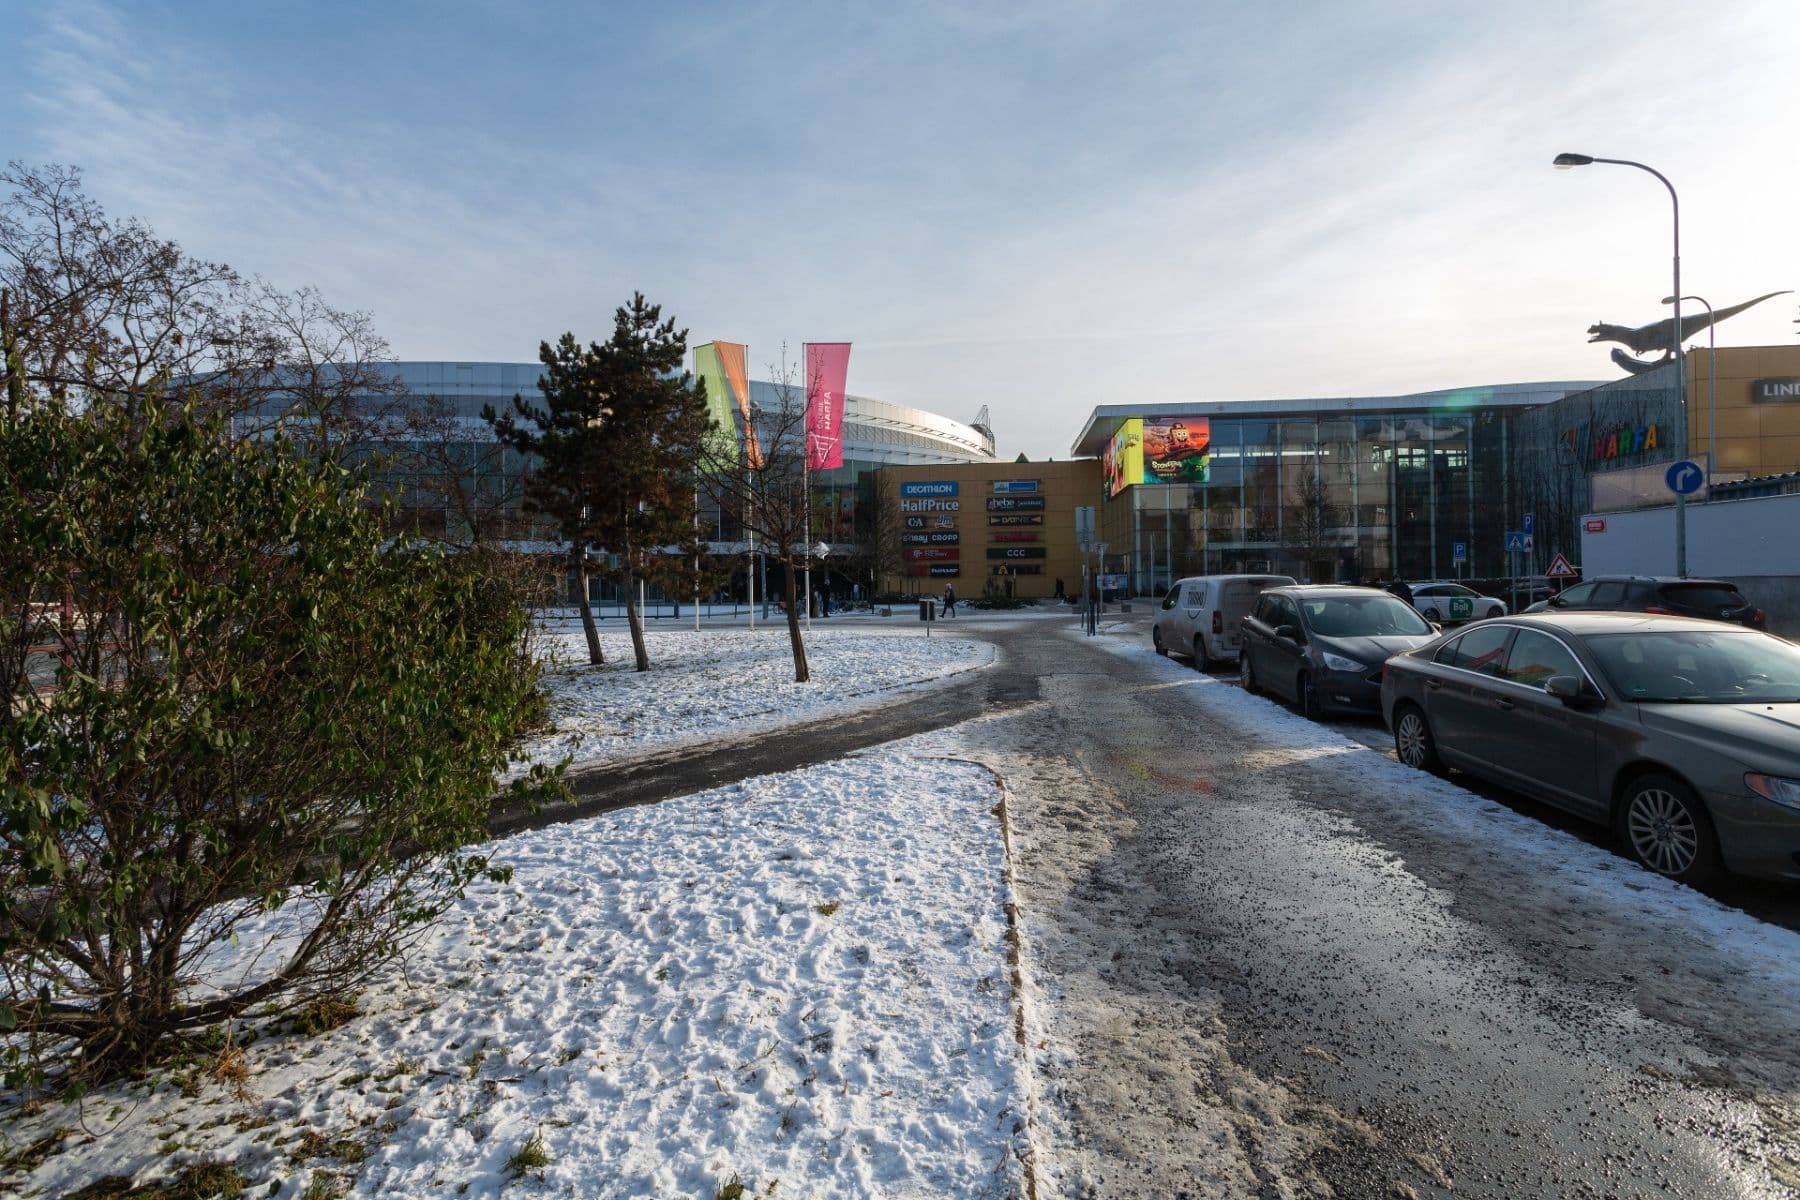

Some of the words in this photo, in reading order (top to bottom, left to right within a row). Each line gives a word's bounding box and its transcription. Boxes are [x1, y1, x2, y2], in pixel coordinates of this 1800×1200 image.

[824, 391, 832, 430] HARFA
[1594, 424, 1658, 460] HARFA
[907, 485, 952, 494] DECATHLON
[901, 499, 959, 511] HalfPrice
[1007, 549, 1025, 557] CCC
[1453, 602, 1469, 611] Bolt
